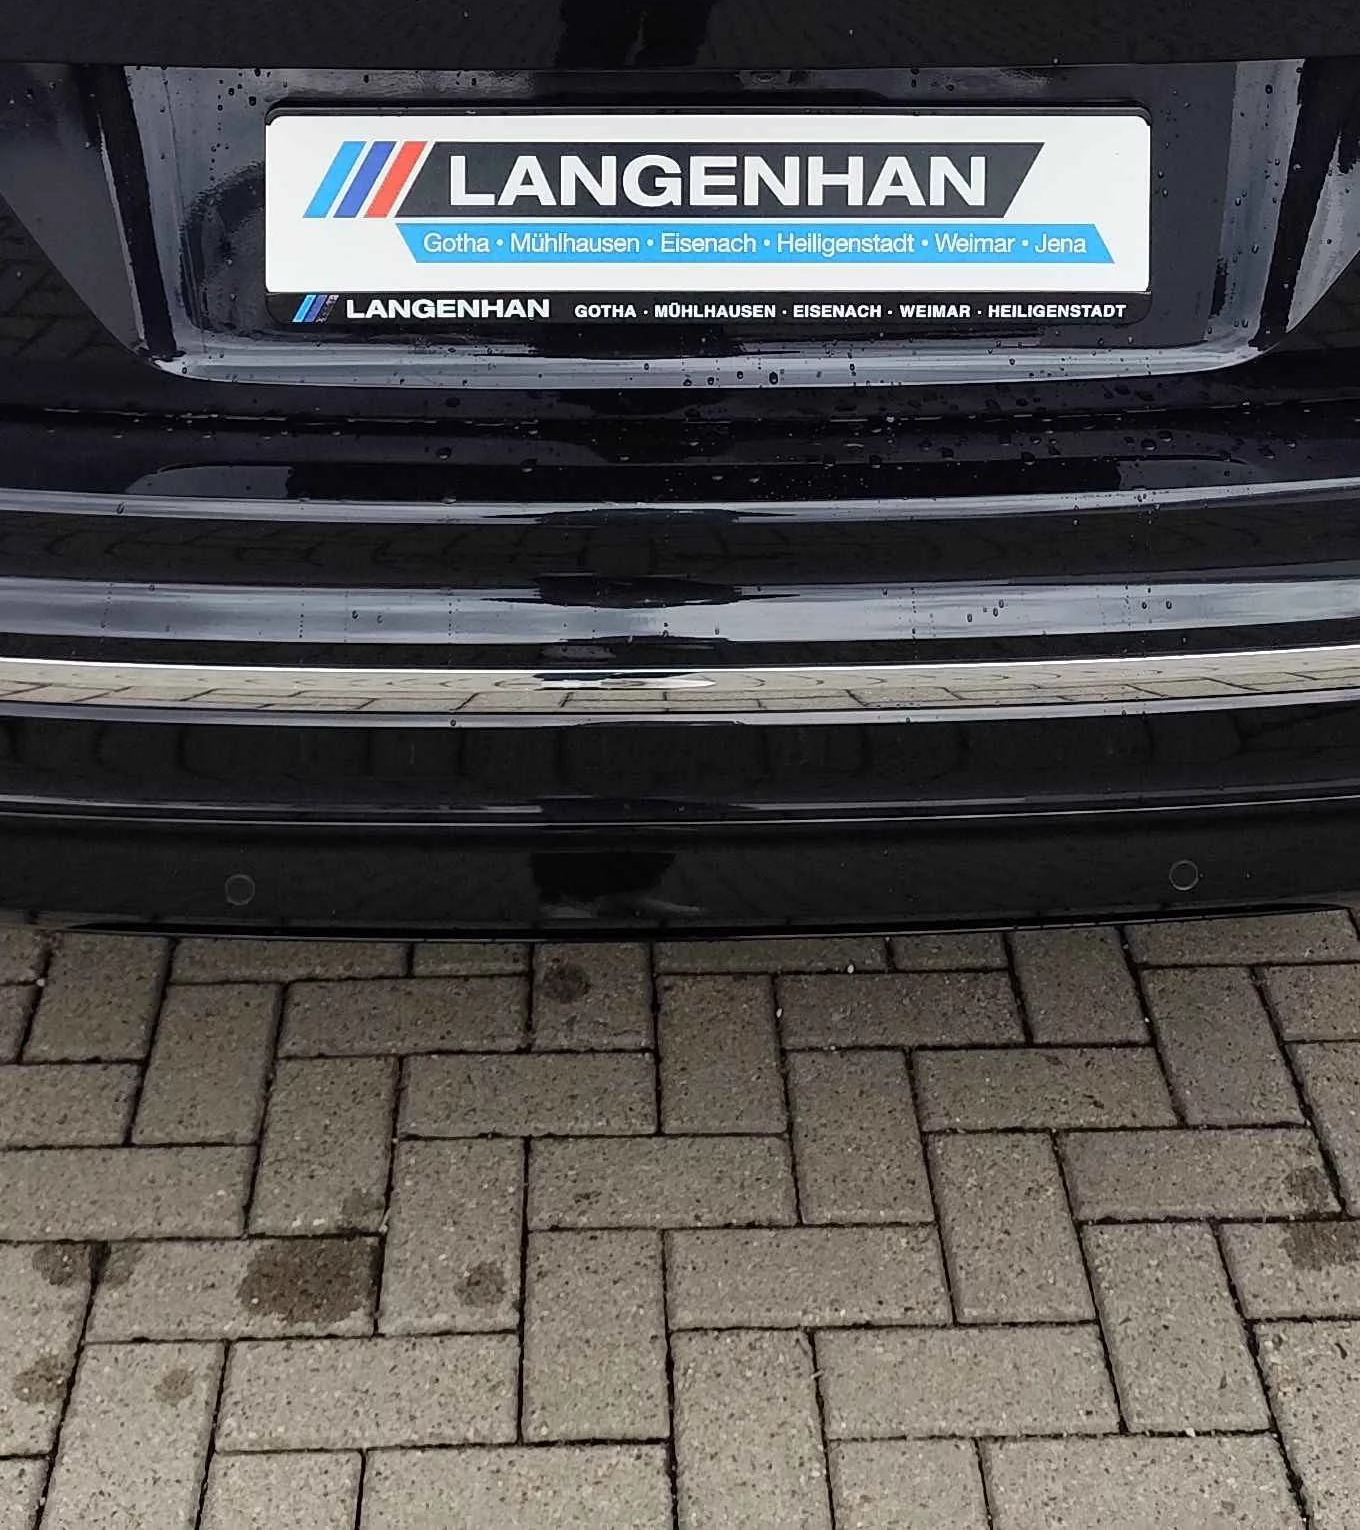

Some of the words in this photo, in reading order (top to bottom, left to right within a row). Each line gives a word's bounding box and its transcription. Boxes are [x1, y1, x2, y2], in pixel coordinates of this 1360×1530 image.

[449, 154, 986, 208] LANGENHAN
[423, 232, 490, 254] Gotha
[510, 232, 640, 254] Mühlhausen
[661, 232, 756, 254] Eisenach
[776, 232, 915, 258] Heiligenstadt
[934, 232, 1016, 254] Weimar
[1034, 232, 1087, 254] Jena
[346, 299, 550, 319] LANGENHAN
[574, 304, 637, 319] GOTHA
[654, 301, 776, 319] MÜHLHAUSEN
[793, 304, 882, 319] EISENACH
[900, 304, 971, 319] WEIMAR
[988, 304, 1126, 319] HEILIGENSTADT
